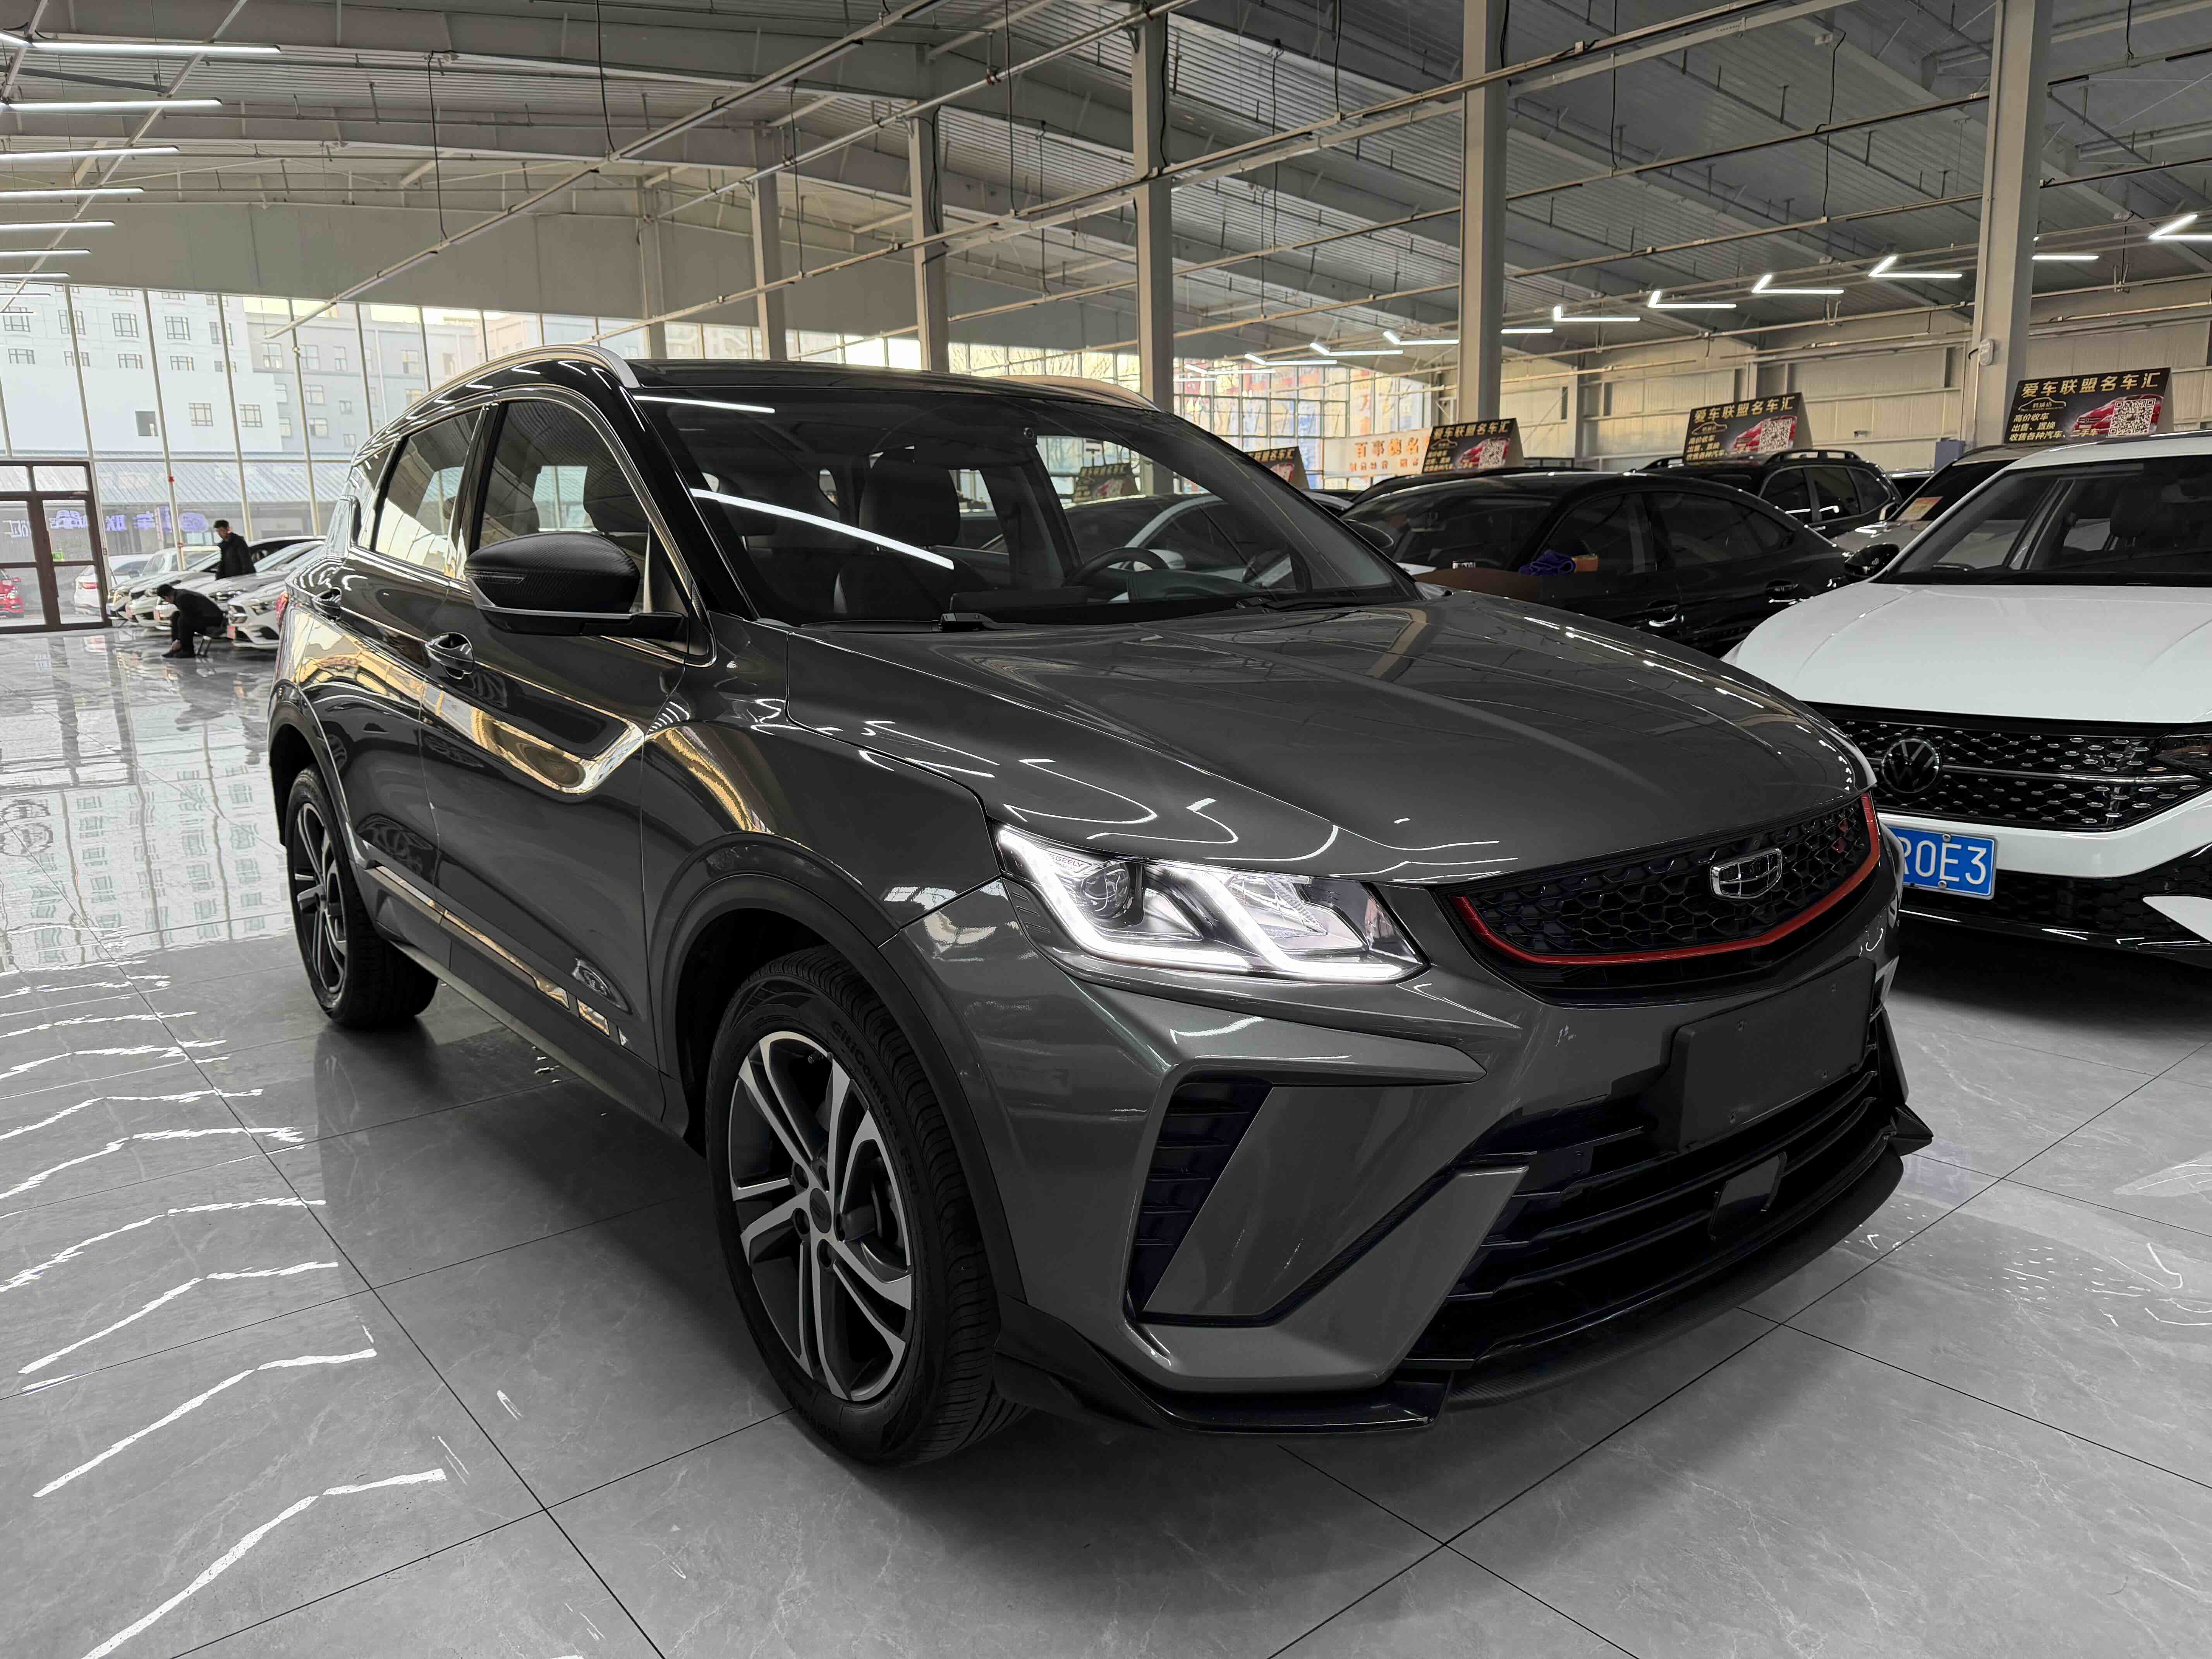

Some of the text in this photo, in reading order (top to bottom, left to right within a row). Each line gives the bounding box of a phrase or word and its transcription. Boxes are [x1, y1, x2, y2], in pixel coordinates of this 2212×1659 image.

[2021, 372, 2161, 398] 爱车联盟名车汇
[1694, 396, 1795, 424] 爱车联盟名车汇
[2013, 412, 2050, 422] 高价收车
[1055, 856, 1084, 867] GEELY
